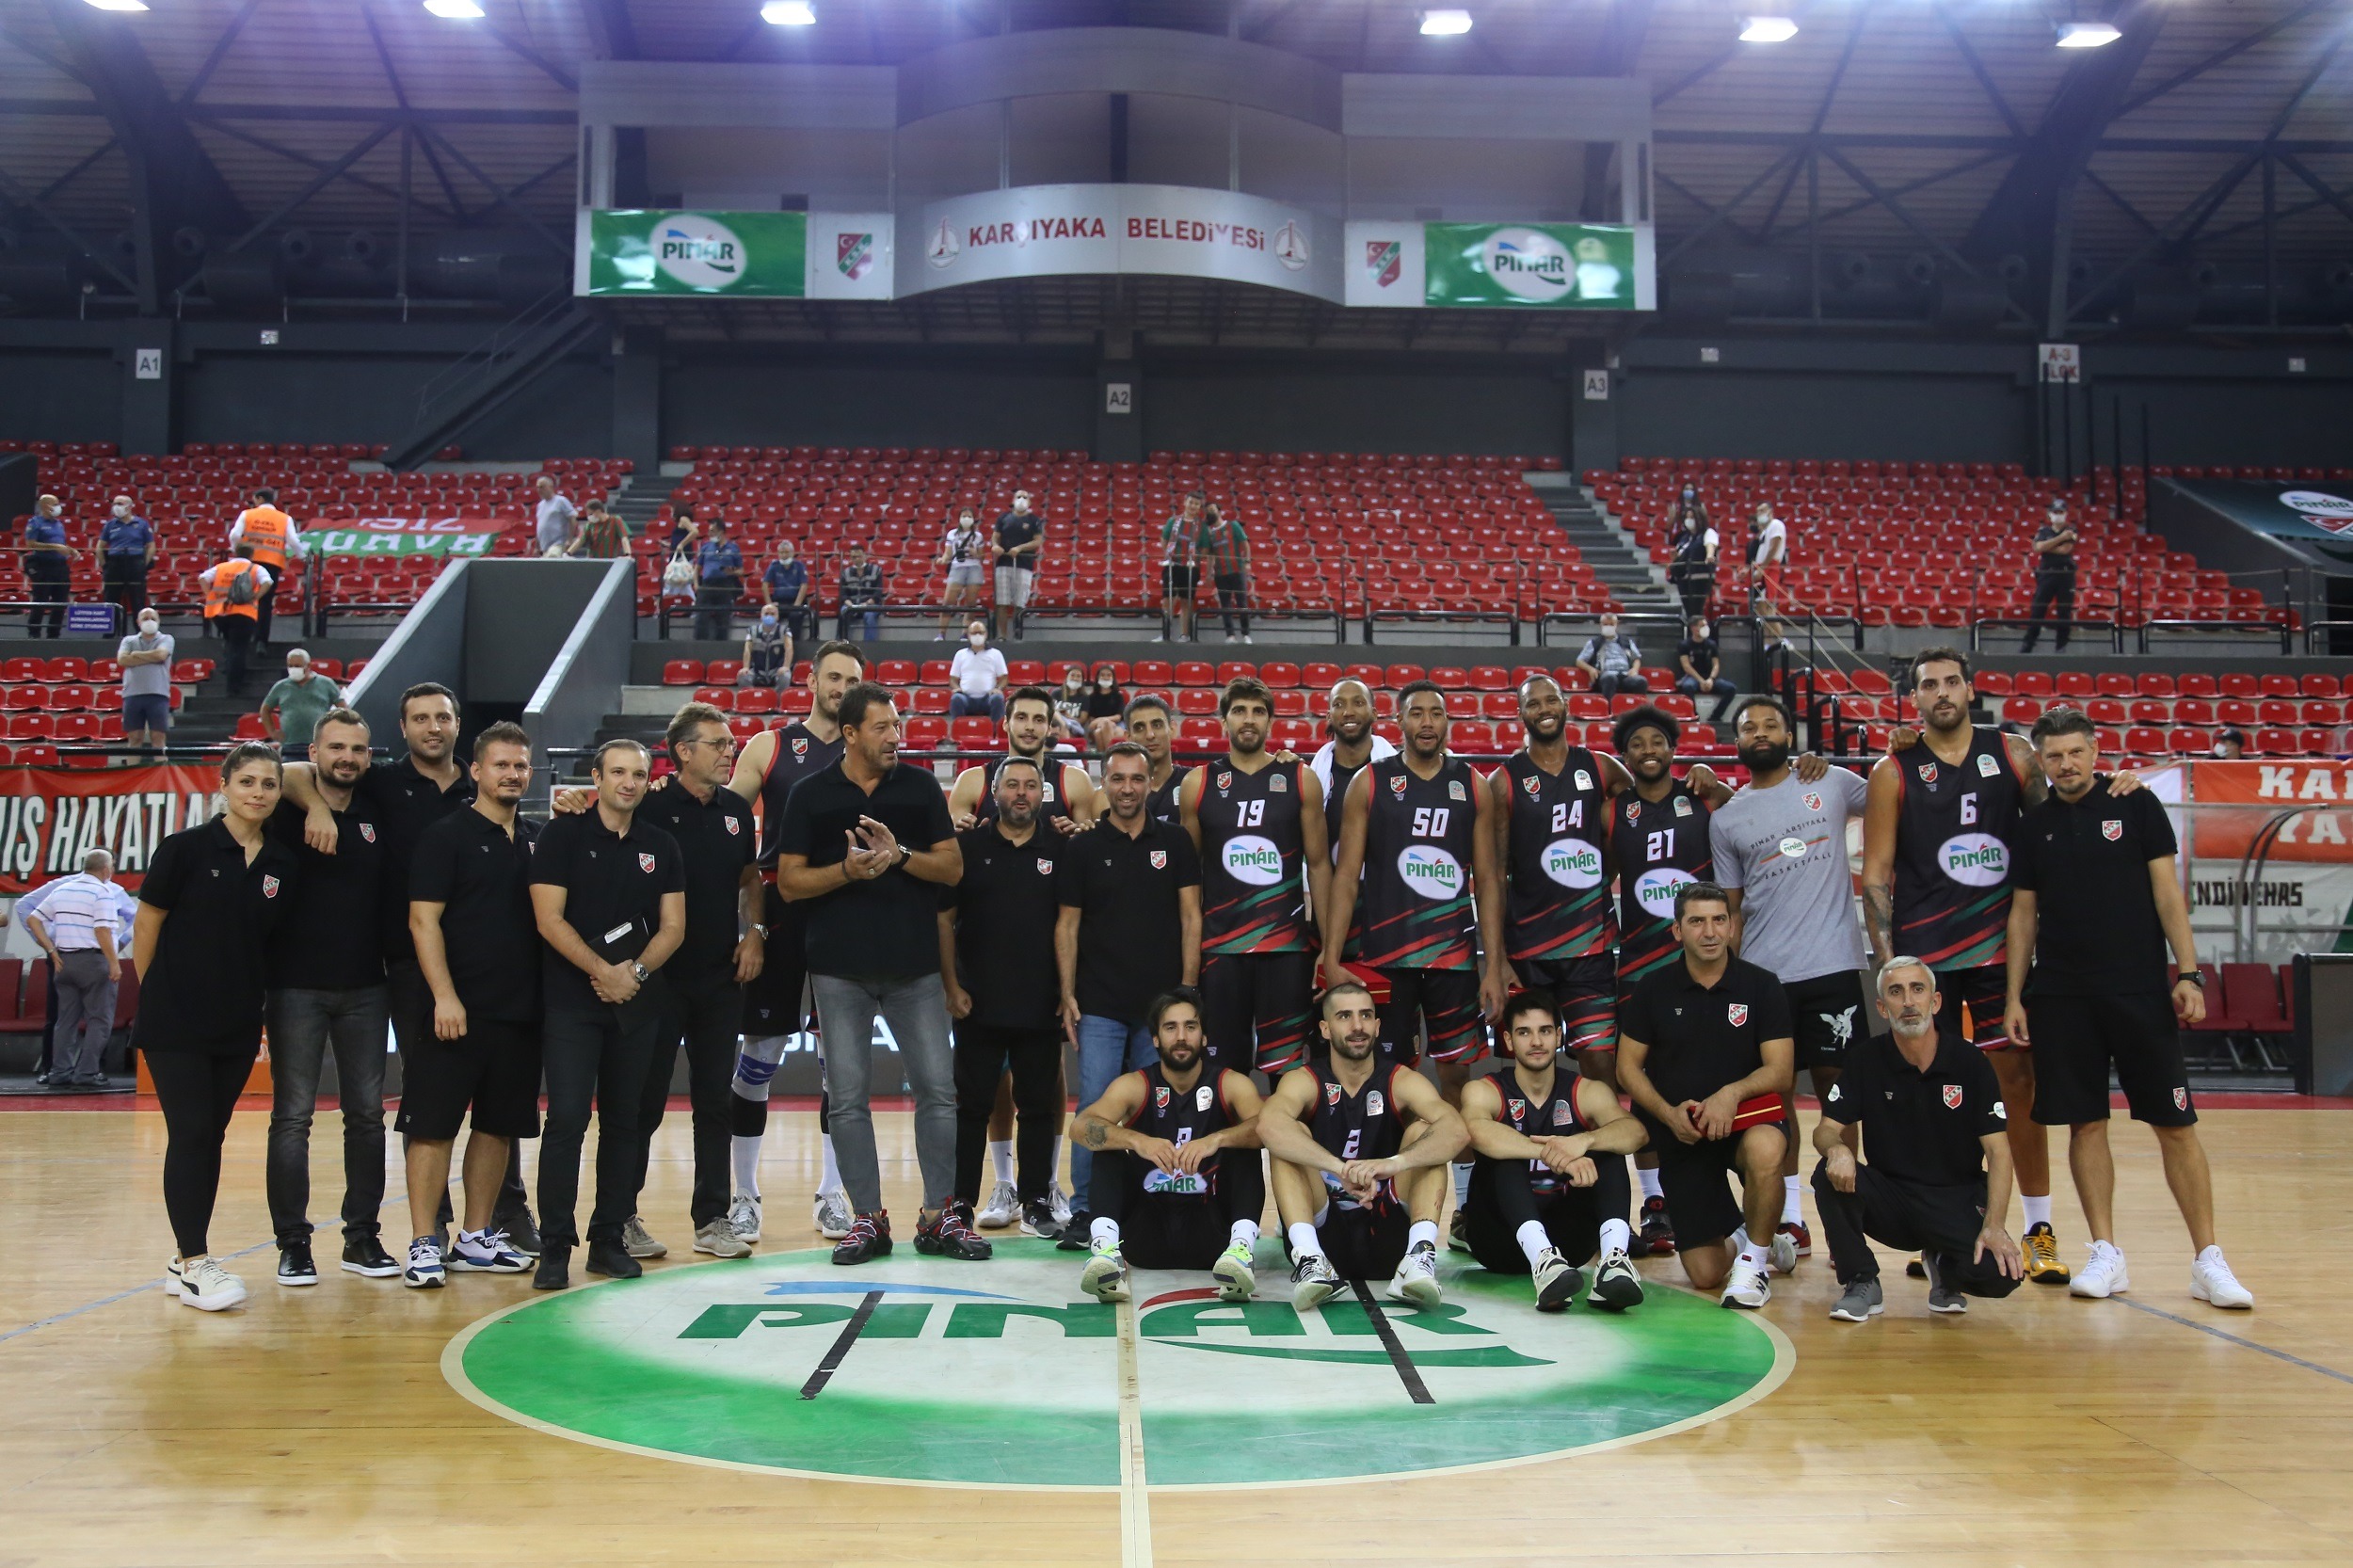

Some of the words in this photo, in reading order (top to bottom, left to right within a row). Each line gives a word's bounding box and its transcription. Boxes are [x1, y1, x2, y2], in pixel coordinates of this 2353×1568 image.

[969, 217, 1106, 248] KARIYAKA
[139, 357, 158, 371] A1
[1110, 391, 1128, 406] A2
[1587, 377, 1606, 392] A3
[2258, 766, 2353, 799] KA
[1237, 799, 1265, 827] 19
[1412, 808, 1449, 838] 50
[1552, 800, 1583, 833] 24
[1961, 792, 1977, 825] 6
[1229, 851, 1278, 867] PINAR
[1646, 828, 1674, 861] 21
[1948, 846, 2003, 870] PINAR
[1406, 863, 1456, 878] PINAR
[1549, 853, 1597, 872] PINAR
[1342, 1129, 1362, 1159] 2
[676, 1301, 1500, 1339] PINAR
